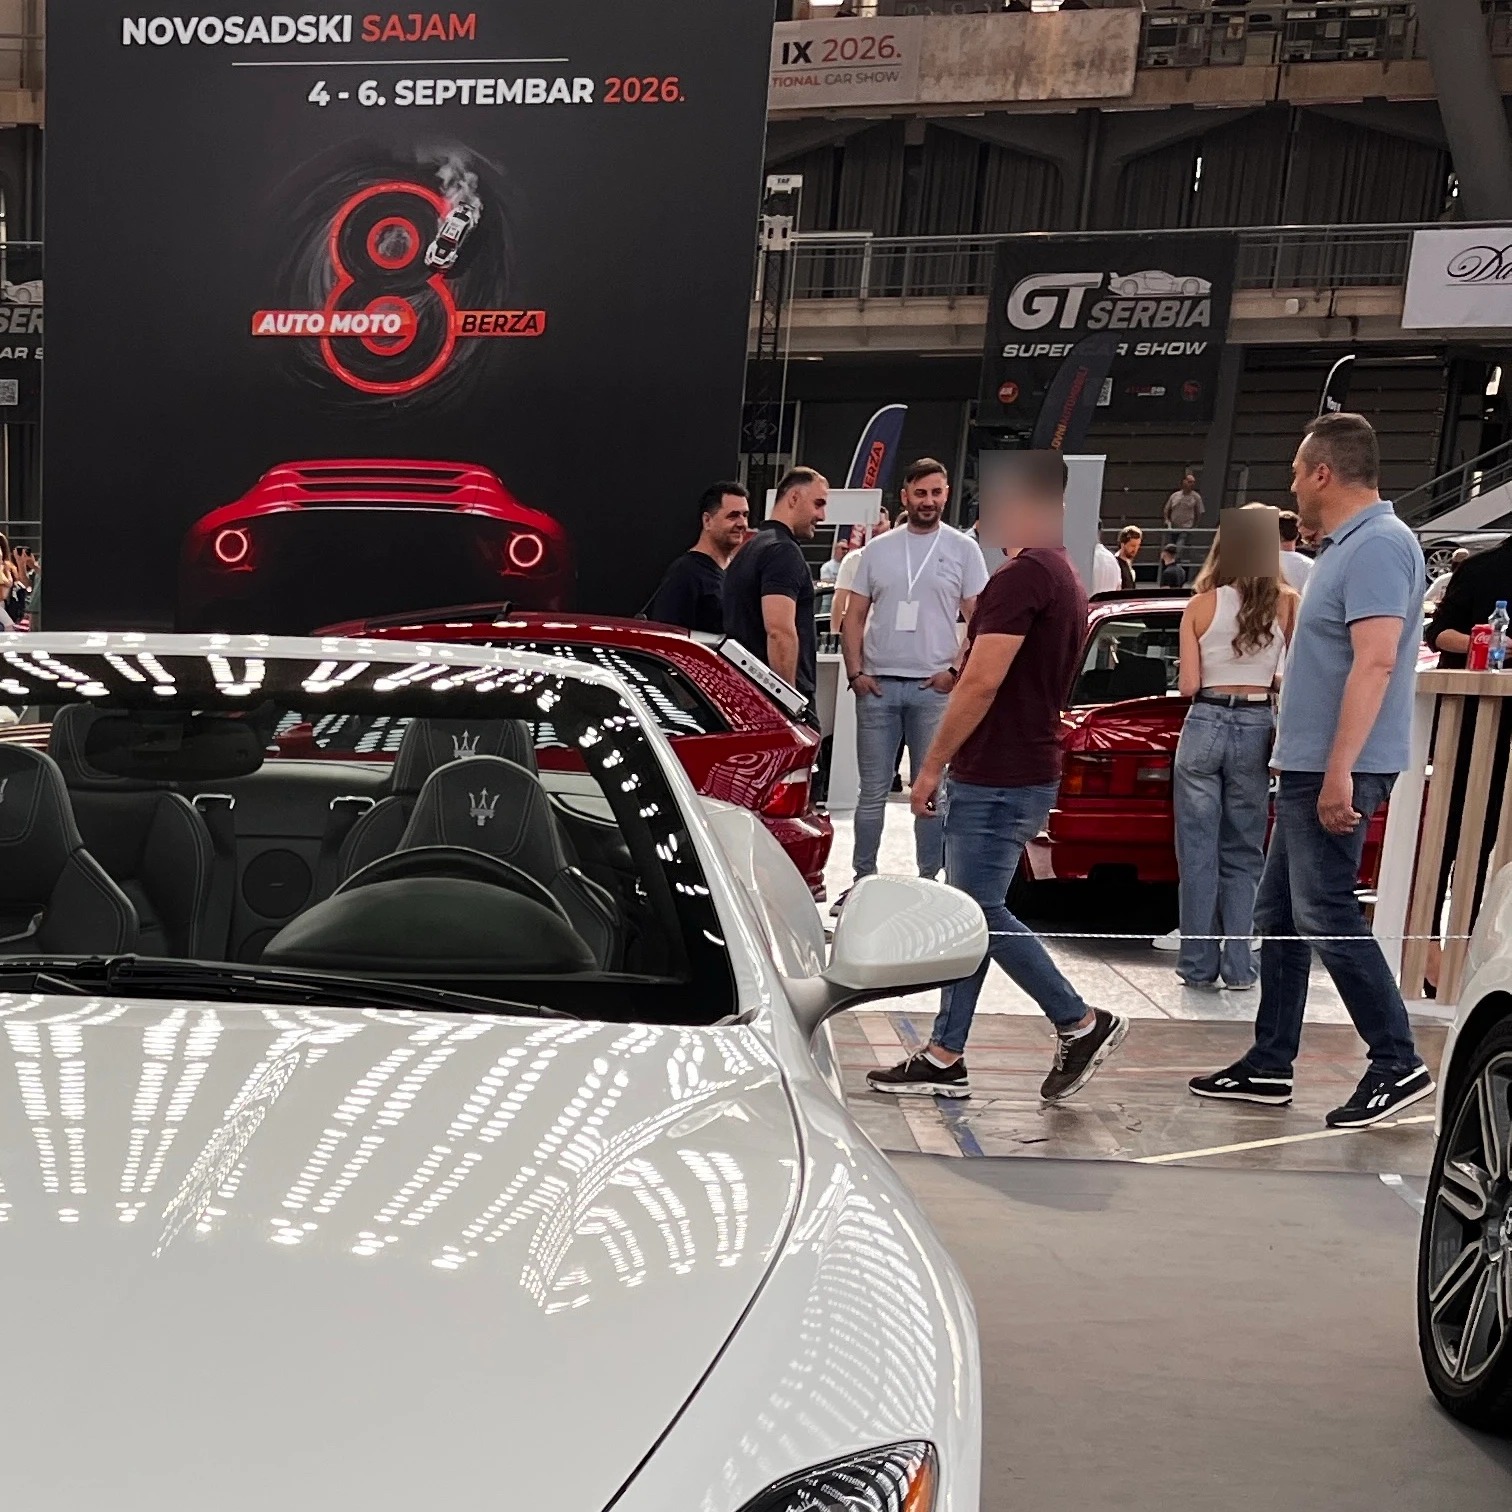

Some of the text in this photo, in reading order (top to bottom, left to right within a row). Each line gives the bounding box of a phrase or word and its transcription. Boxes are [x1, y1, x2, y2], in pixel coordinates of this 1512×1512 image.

[122, 13, 476, 45] NOVOSADSKI SAJAM
[781, 35, 901, 65] IX 2026.
[307, 80, 330, 106] 4
[357, 80, 386, 107] 6.
[394, 77, 595, 106] SEPTEMBAR
[603, 76, 685, 103] 2026.
[772, 71, 900, 88] TIONAL CAR SHOW
[1006, 272, 1212, 331] GT SERBIA
[258, 312, 539, 334] AUTO MOTO BERZA
[1134, 342, 1207, 356] SHOW
[863, 446, 883, 489] ERZA
